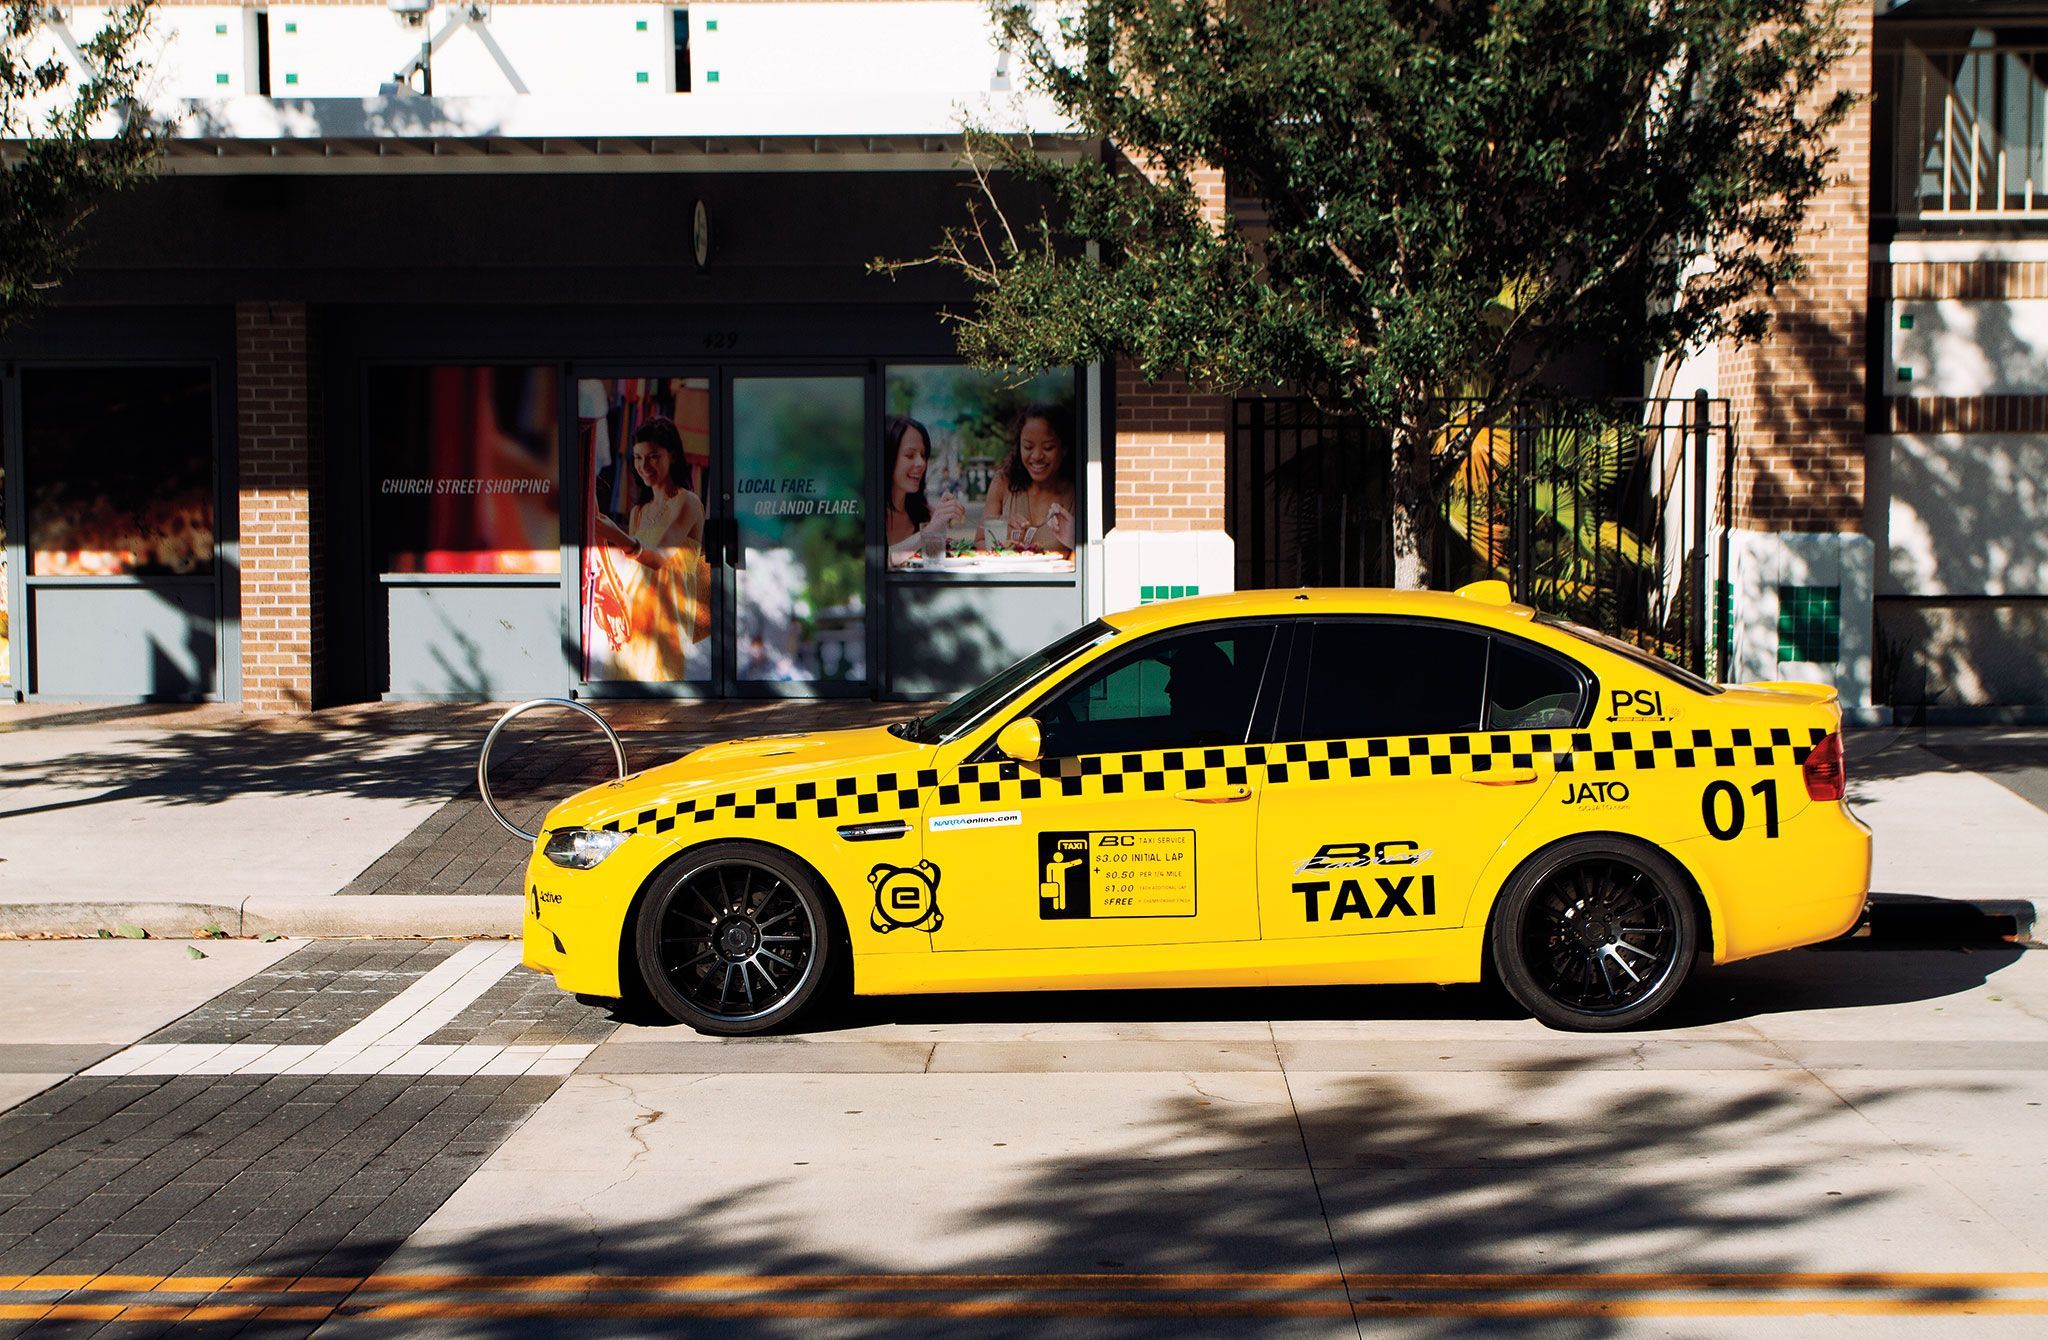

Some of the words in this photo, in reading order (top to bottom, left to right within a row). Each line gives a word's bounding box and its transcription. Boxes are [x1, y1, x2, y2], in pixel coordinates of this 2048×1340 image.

[381, 479, 433, 494] CHURCH
[435, 479, 484, 494] STREET
[485, 479, 551, 494] SHOPPING
[737, 479, 776, 494] LOCAL
[780, 479, 816, 494] FARE.
[754, 499, 814, 515] ORLANDO
[817, 499, 860, 515] FLARE.
[1611, 689, 1663, 716] PSI
[1561, 781, 1630, 805] JATO
[1701, 779, 1779, 841] 01
[1062, 841, 1083, 850] TAXI
[1157, 836, 1185, 844] SERVICE
[1095, 853, 1128, 863] $3.00
[1131, 853, 1161, 862] INITIAL
[1165, 852, 1184, 862] LAP
[1105, 871, 1135, 879] $0.50
[1104, 884, 1134, 893] $1.00
[1104, 897, 1133, 906] $FREE
[1292, 875, 1436, 922] TAXI
